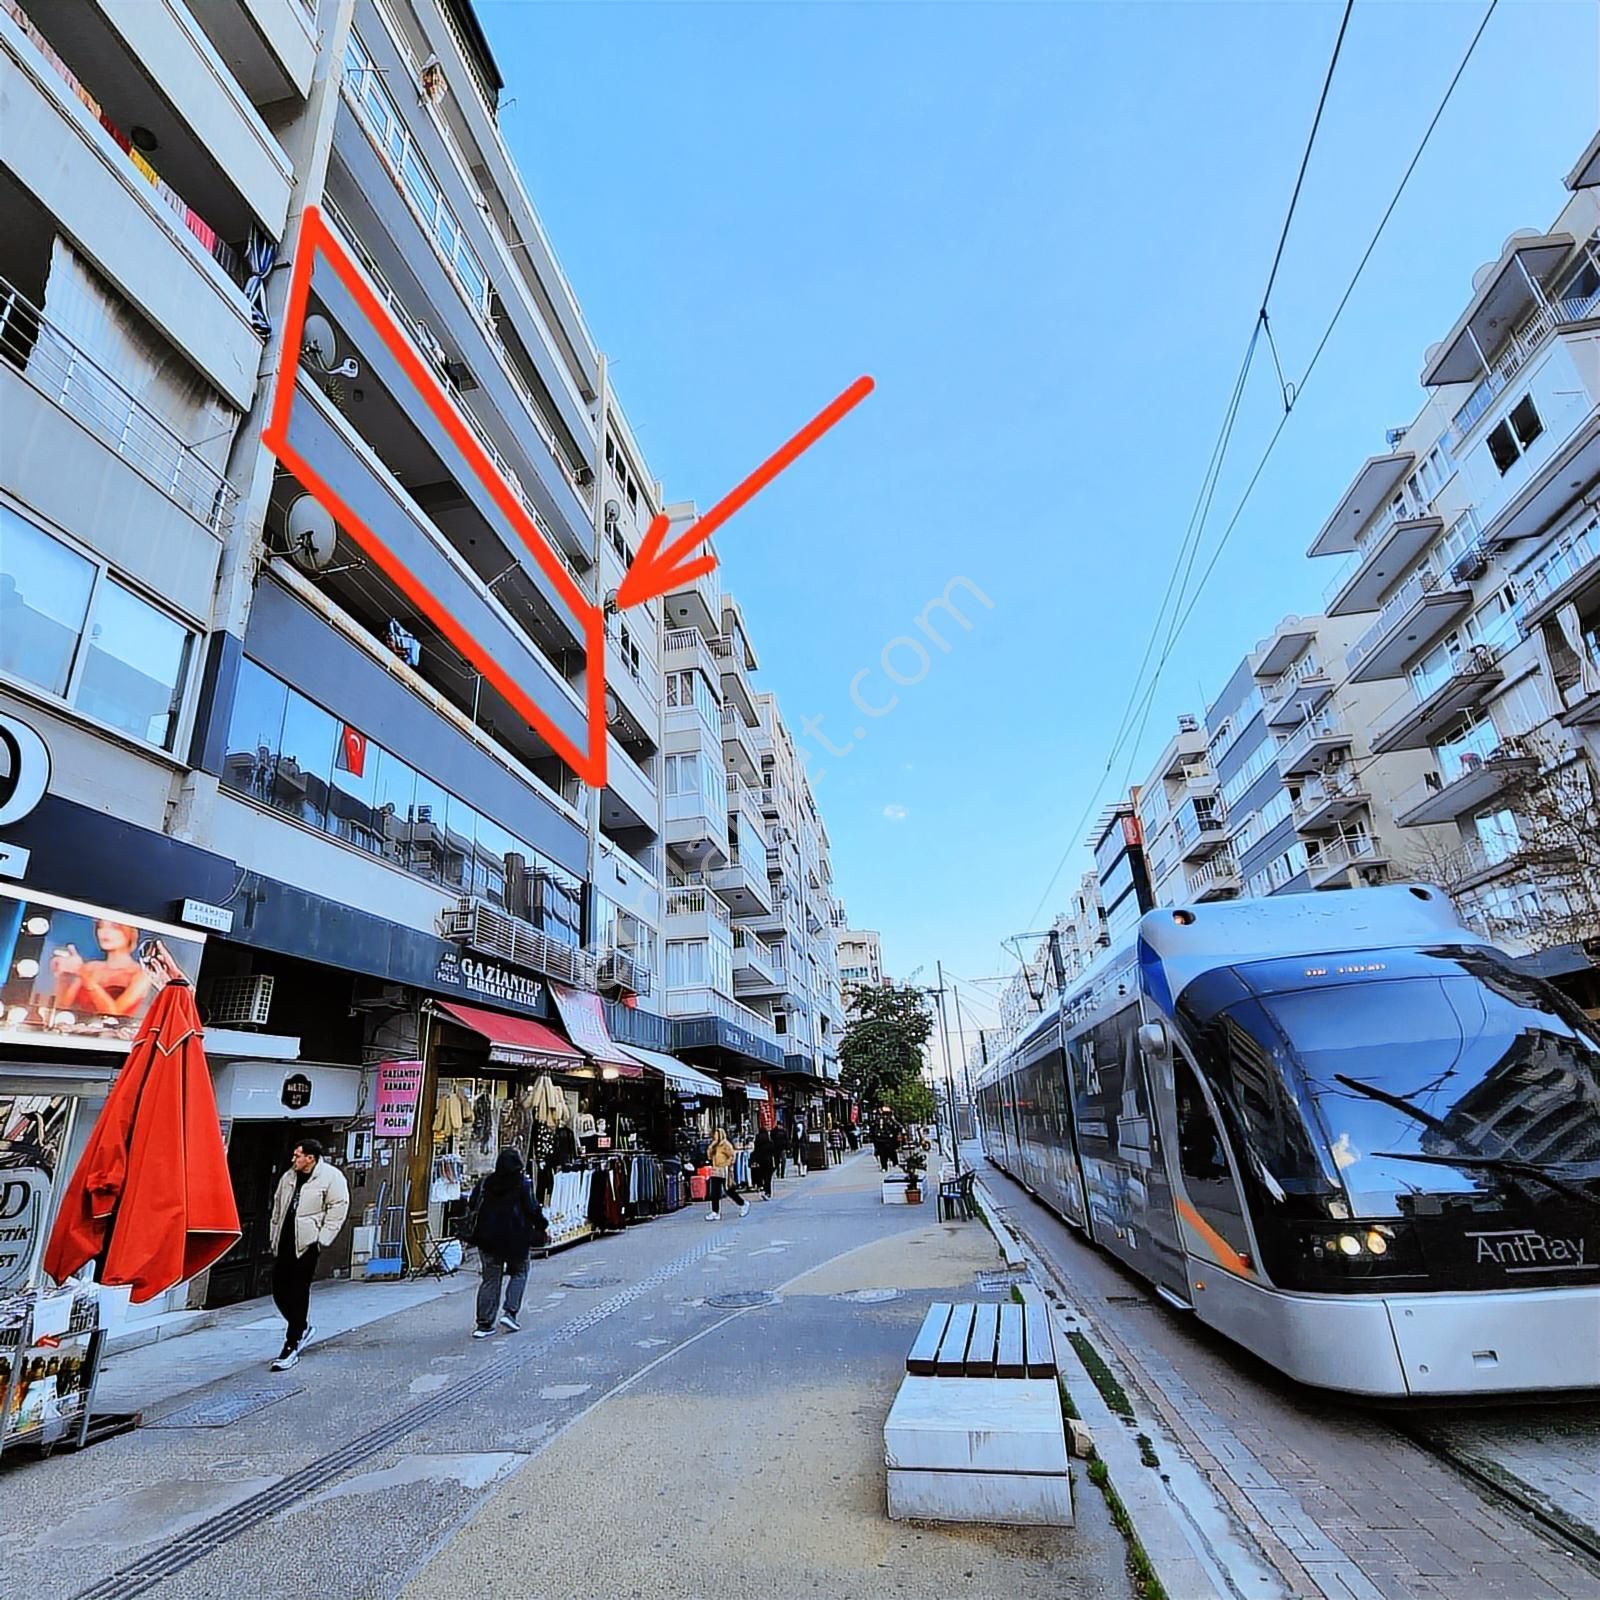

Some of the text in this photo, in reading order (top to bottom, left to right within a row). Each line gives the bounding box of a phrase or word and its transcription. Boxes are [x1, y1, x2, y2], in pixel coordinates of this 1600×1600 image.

[437, 972, 460, 984] POLEN
[461, 958, 542, 997] GAZİANTEP
[384, 1082, 415, 1091] BAHARAT
[383, 1117, 408, 1127] POLEN
[1477, 1234, 1585, 1267] AntRay
